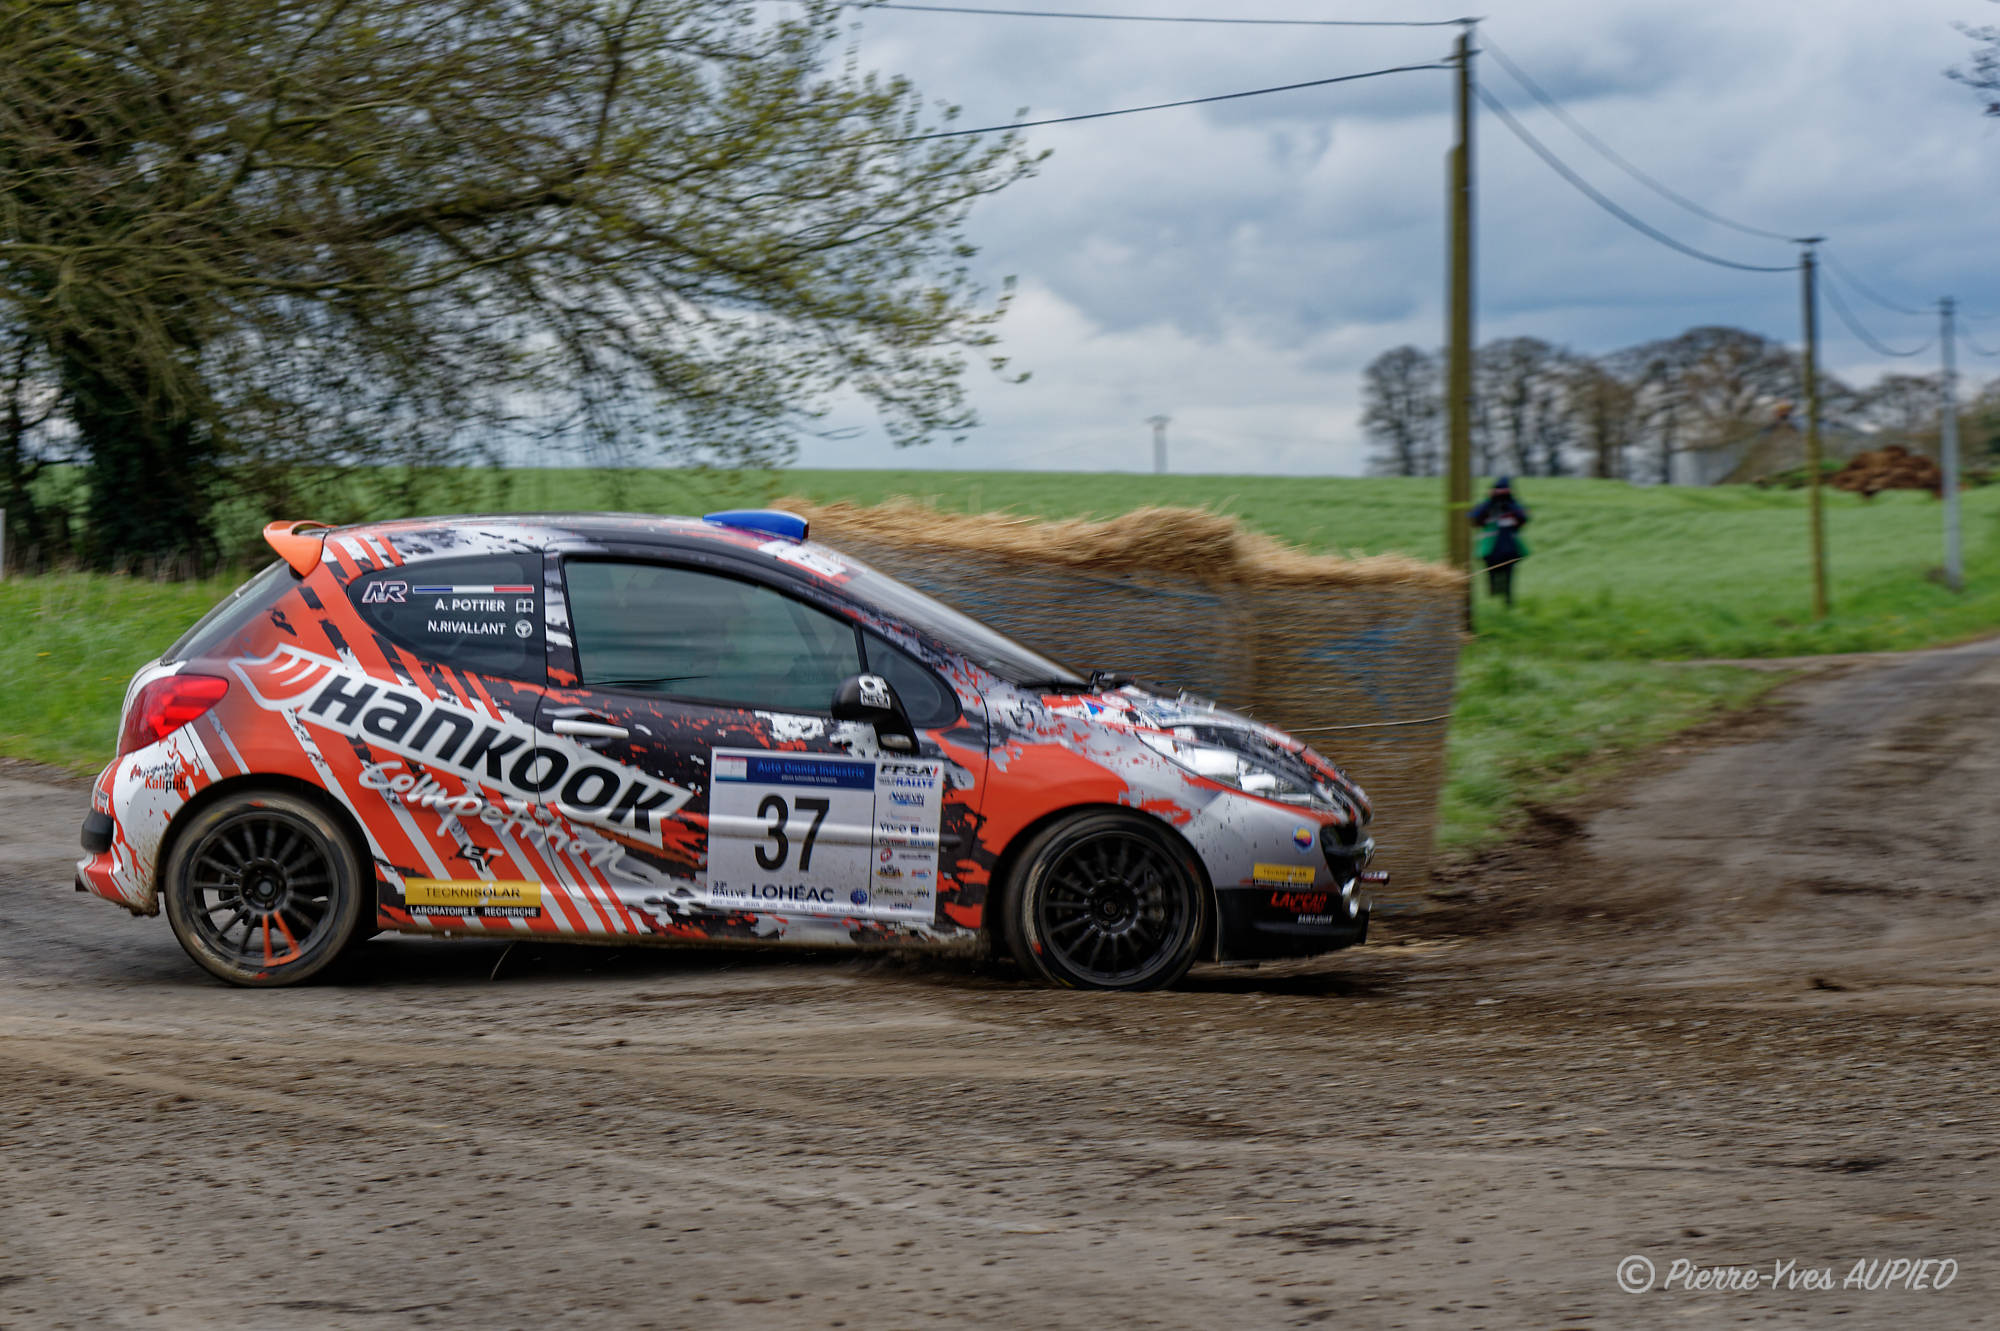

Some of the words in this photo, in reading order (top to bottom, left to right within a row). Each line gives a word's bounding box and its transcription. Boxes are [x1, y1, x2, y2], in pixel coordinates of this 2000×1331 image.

[435, 599, 449, 611] A.
[452, 598, 506, 612] POTTIER
[427, 619, 507, 635] N.RIVALLANT
[757, 760, 781, 773] Auto
[881, 763, 933, 777] FFSA
[145, 774, 186, 793] Kalipub
[896, 776, 935, 789] RALLYE
[754, 793, 830, 872] 37
[425, 886, 521, 898] TECKNISOLAR
[752, 881, 835, 902] LOHÉAC
[410, 905, 470, 916] LABORATOIRE
[485, 906, 537, 917] RECHERCHE
